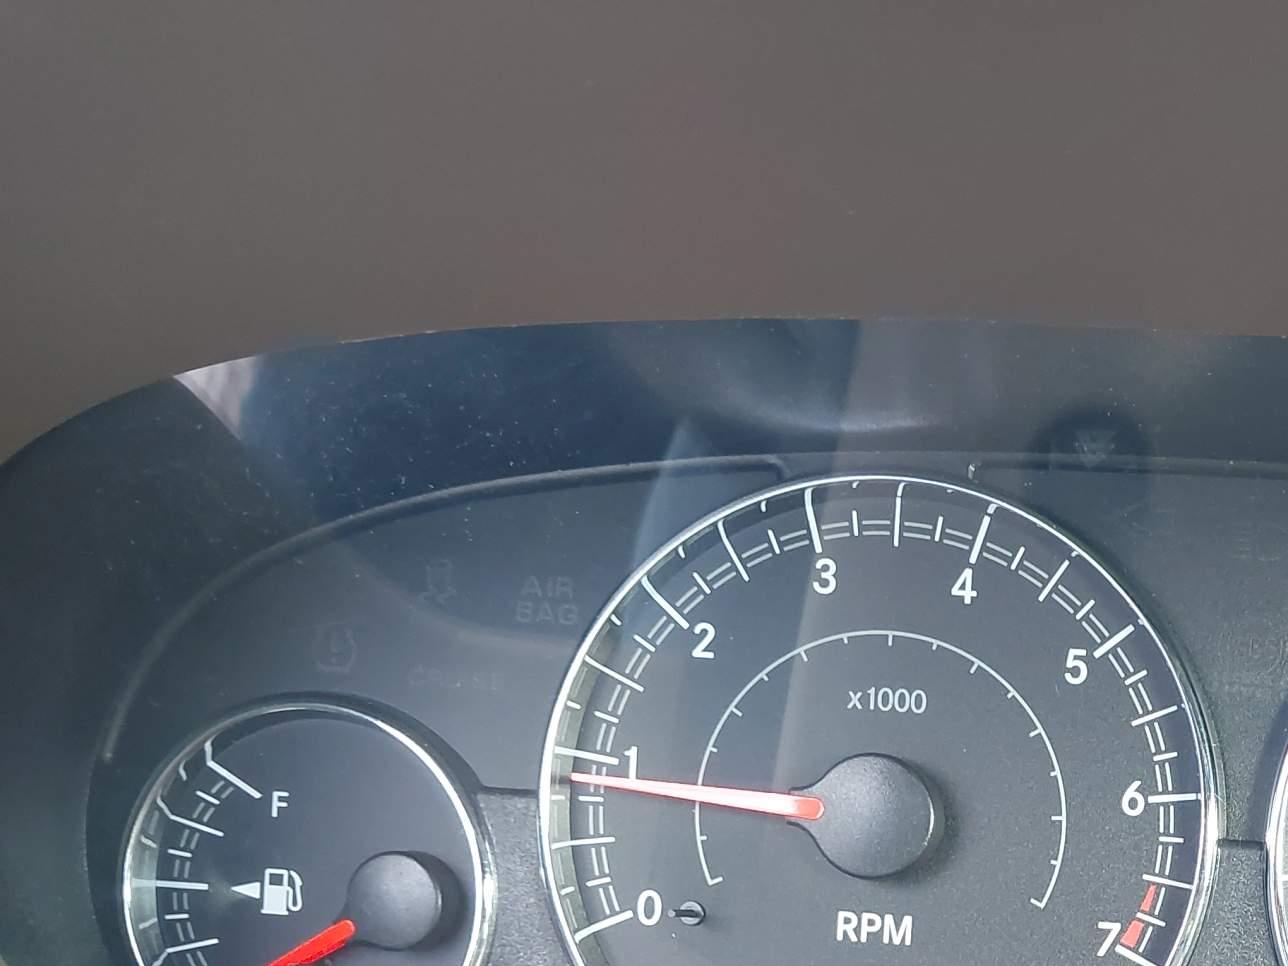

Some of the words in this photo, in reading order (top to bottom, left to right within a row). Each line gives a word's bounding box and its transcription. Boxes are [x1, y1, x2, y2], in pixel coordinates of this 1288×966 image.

[520, 576, 574, 598] AIR
[813, 559, 837, 594] 3
[951, 568, 978, 604] 4
[515, 601, 578, 624] BAG
[691, 622, 716, 658] 2
[1065, 649, 1088, 684] 5
[847, 687, 927, 713] x1000
[624, 746, 638, 779] 1
[271, 791, 289, 817] F
[1121, 781, 1145, 816] 6
[637, 890, 662, 925] 0
[836, 911, 913, 946] RPM
[1097, 922, 1123, 957] 7
